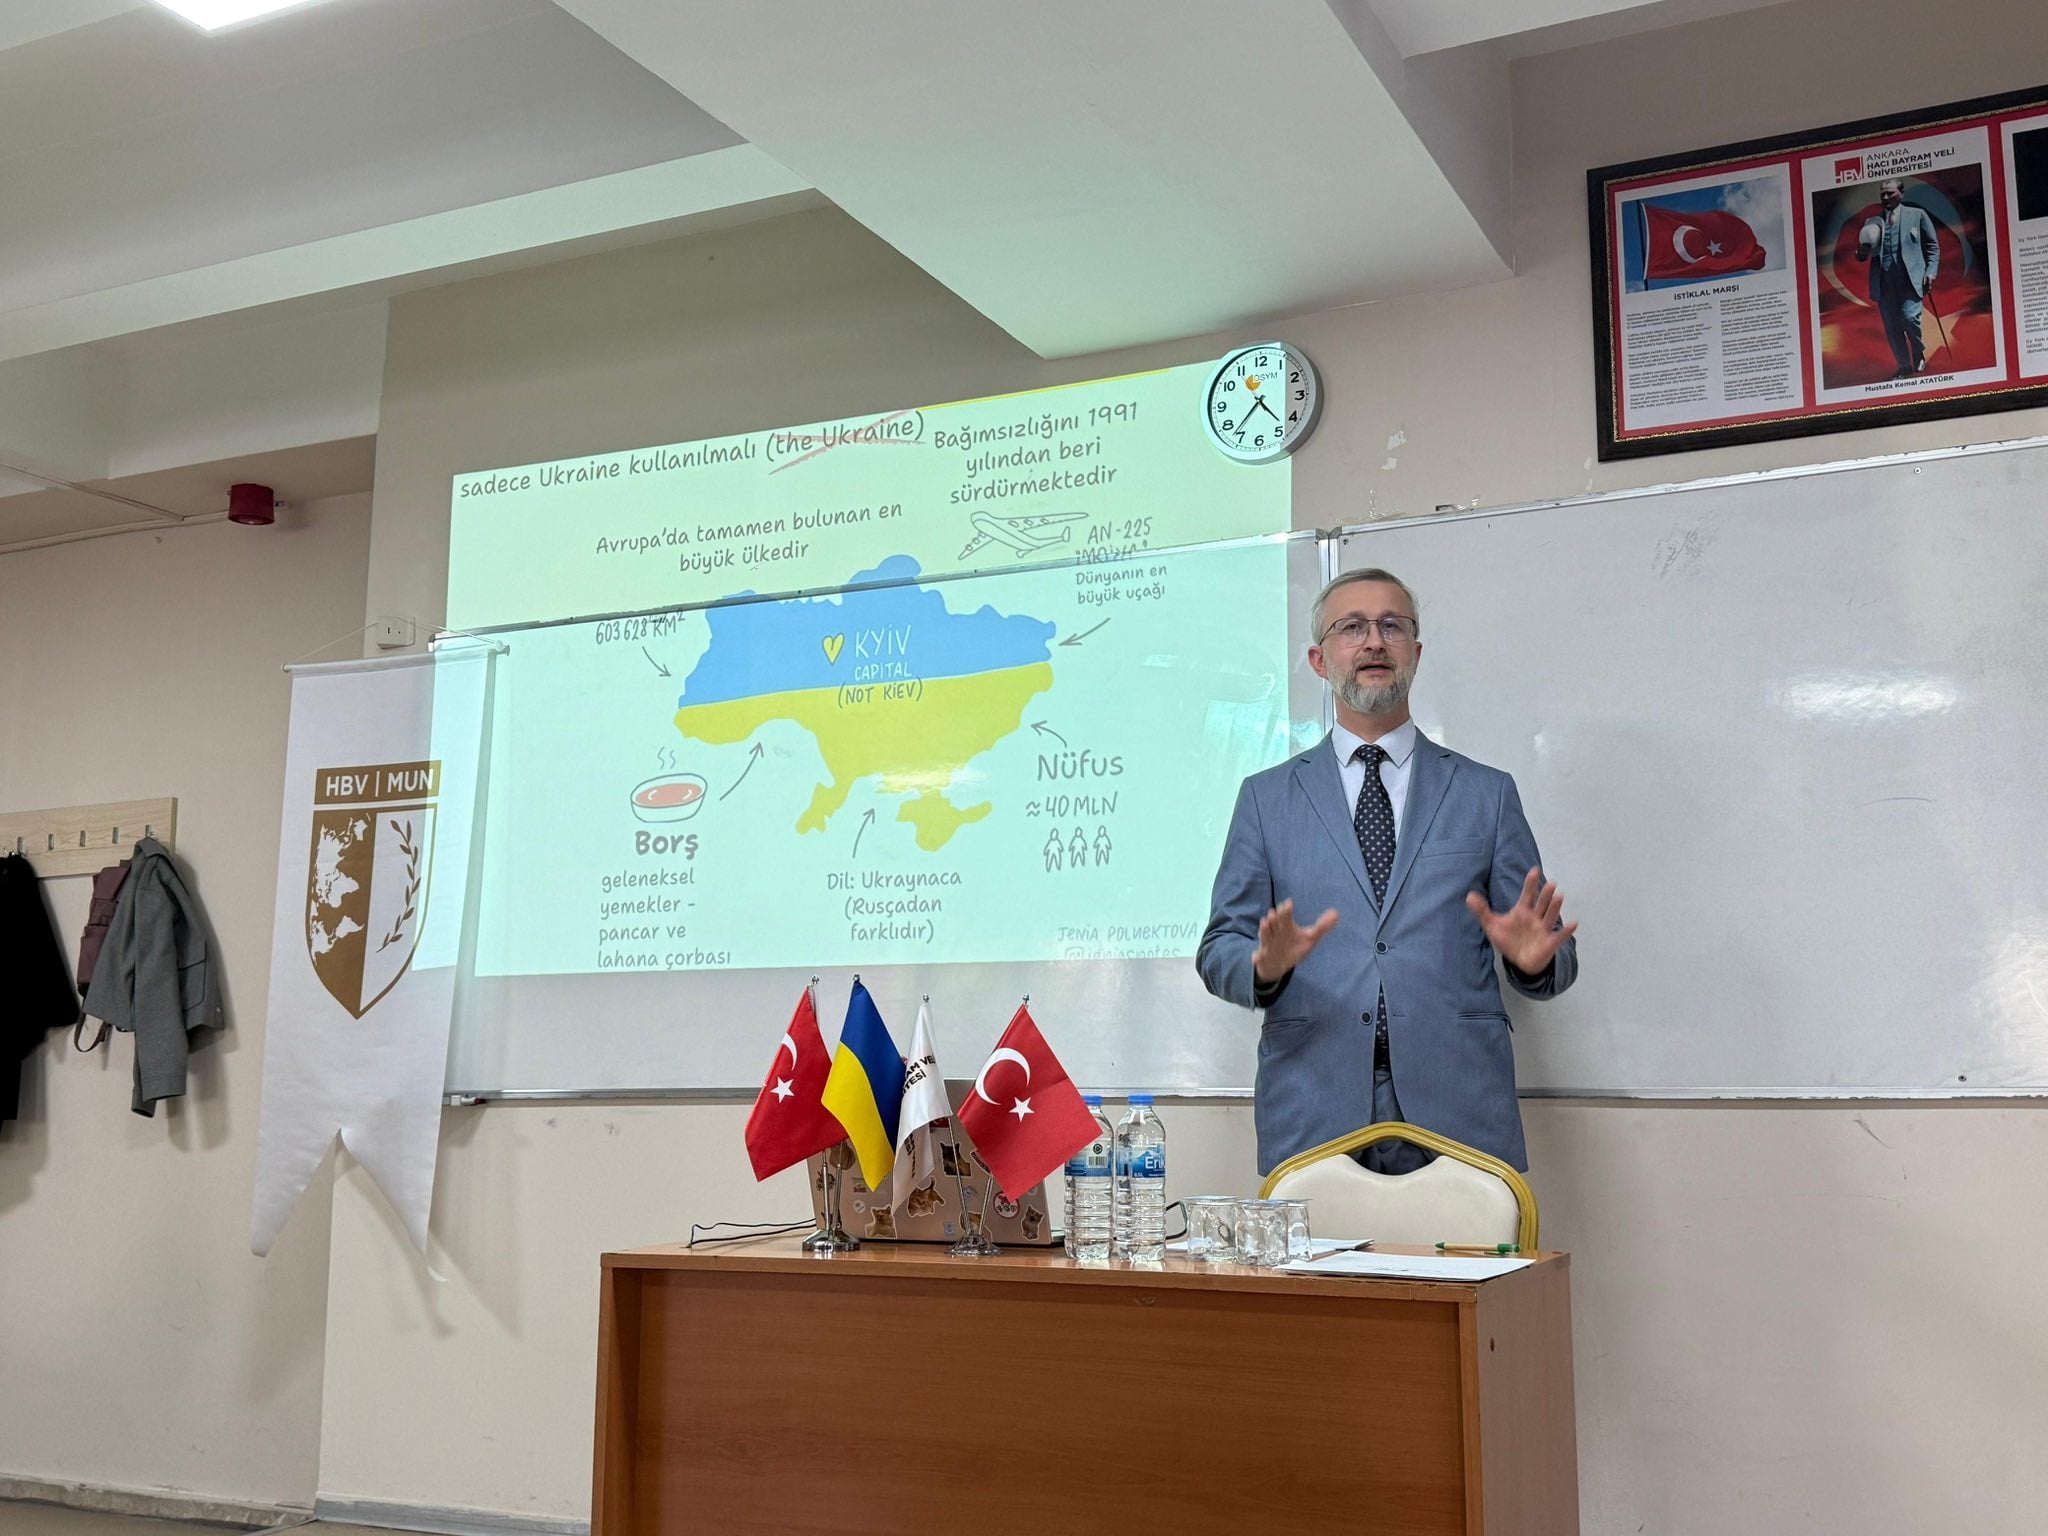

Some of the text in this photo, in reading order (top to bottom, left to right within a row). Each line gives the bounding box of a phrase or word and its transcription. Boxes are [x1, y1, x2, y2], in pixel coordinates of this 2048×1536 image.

[1866, 148, 1909, 161] ANKARA
[1867, 146, 1955, 170] HACI BAYRAM VELİ
[1867, 160, 1932, 179] ÜNİVERSİTESİ
[1712, 284, 1739, 295] MARŞI
[1238, 365, 1246, 377] 11
[1255, 356, 1268, 367] 12
[1279, 360, 1282, 370] 1
[1223, 380, 1236, 392] 10
[1290, 372, 1300, 383] 2
[1865, 374, 1954, 392] Mustafa Kemal ATATÜRK
[1294, 390, 1305, 401] 3
[1217, 402, 1227, 412] 9
[1289, 410, 1298, 422] 4
[934, 402, 1139, 451] Bağımsızlığını 1991
[1222, 419, 1234, 431] 8
[1274, 426, 1283, 437] 5
[1236, 431, 1246, 444] 7
[1254, 435, 1264, 446] 6
[460, 411, 926, 499] sadece Ukraine kullanılmalı (the Ukraine)
[966, 436, 1101, 479] yılından beri
[950, 466, 1118, 504] sürdürmektedir
[596, 503, 903, 555] Avrupa'da tamamen bulunan en
[680, 541, 810, 575] büyük ülkedir
[1075, 565, 1168, 587] Dünyanın en
[1077, 582, 1165, 606] büyük uçağı
[595, 620, 621, 645] 603
[624, 617, 648, 641] 628
[854, 661, 913, 682] CAPITAL
[837, 685, 875, 709] (NOT
[1037, 749, 1125, 781] Nüfus
[325, 768, 434, 798] HBV MUN
[634, 830, 700, 861] Borş
[601, 867, 696, 893] geleneksel
[827, 870, 963, 895] Dil: Ukraynaca
[600, 896, 682, 920] yemekler
[844, 898, 943, 922] (Rusçadan
[599, 923, 687, 946] pancar ve
[850, 919, 936, 944] farklıdır)
[597, 949, 731, 971] lahana çorbası
